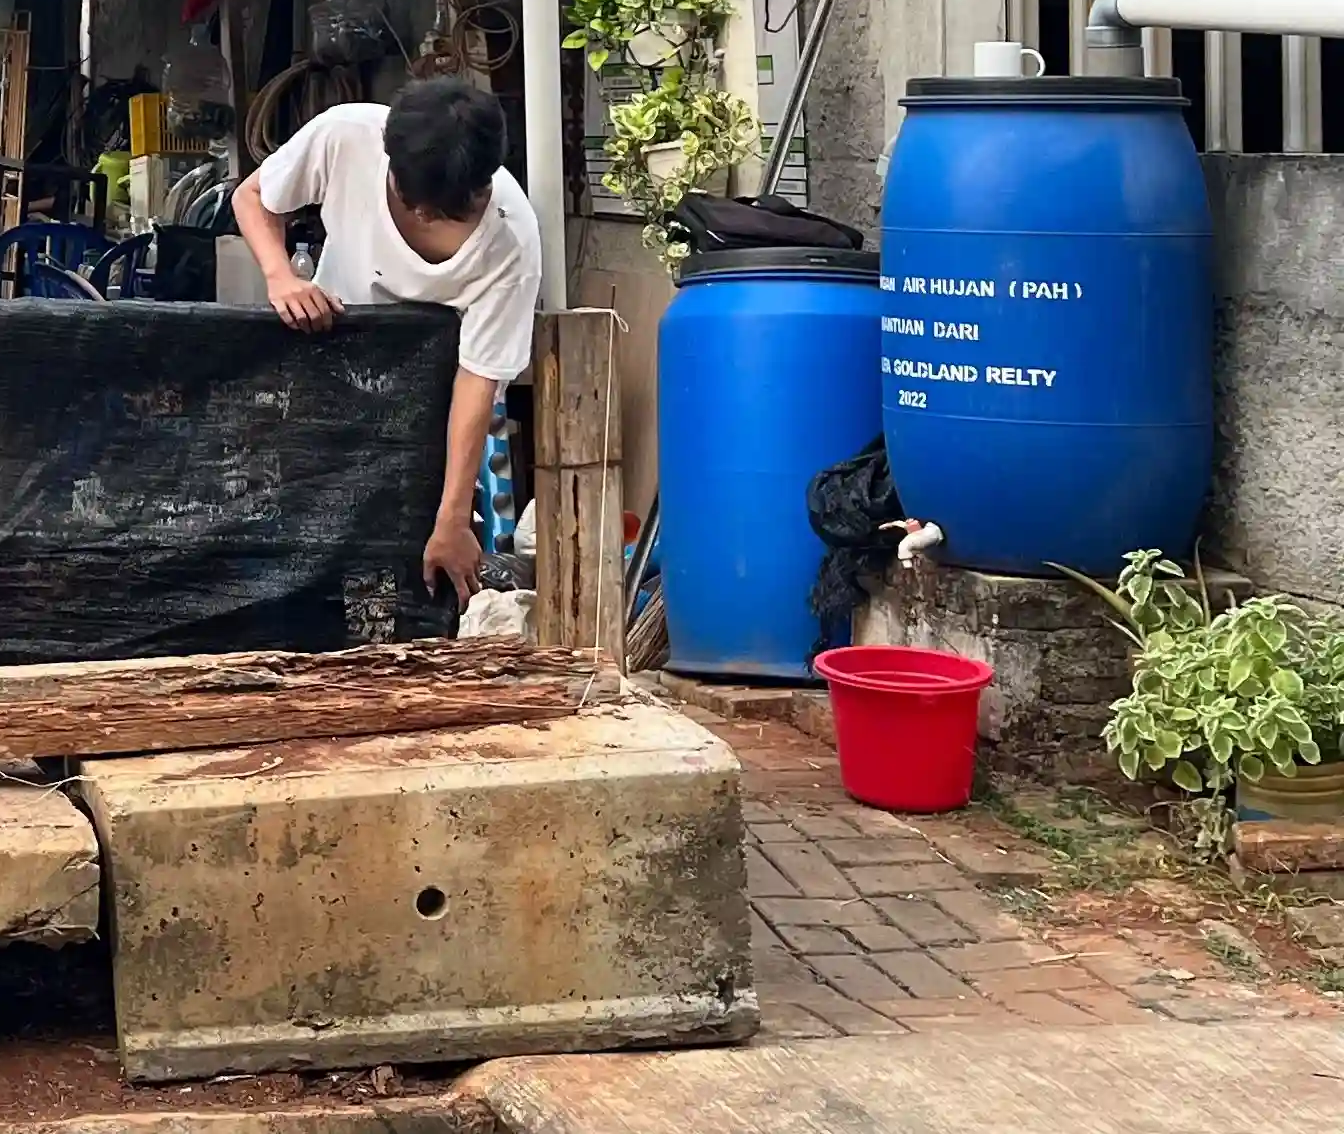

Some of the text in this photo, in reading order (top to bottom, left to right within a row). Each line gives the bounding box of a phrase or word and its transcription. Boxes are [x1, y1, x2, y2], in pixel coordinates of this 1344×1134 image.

[903, 277, 926, 294] AIR
[930, 278, 995, 297] HUJAN
[933, 322, 980, 341] DARI
[893, 359, 978, 382] GOLDLAND
[986, 366, 1057, 386] RELTY
[898, 390, 927, 408] 2022
